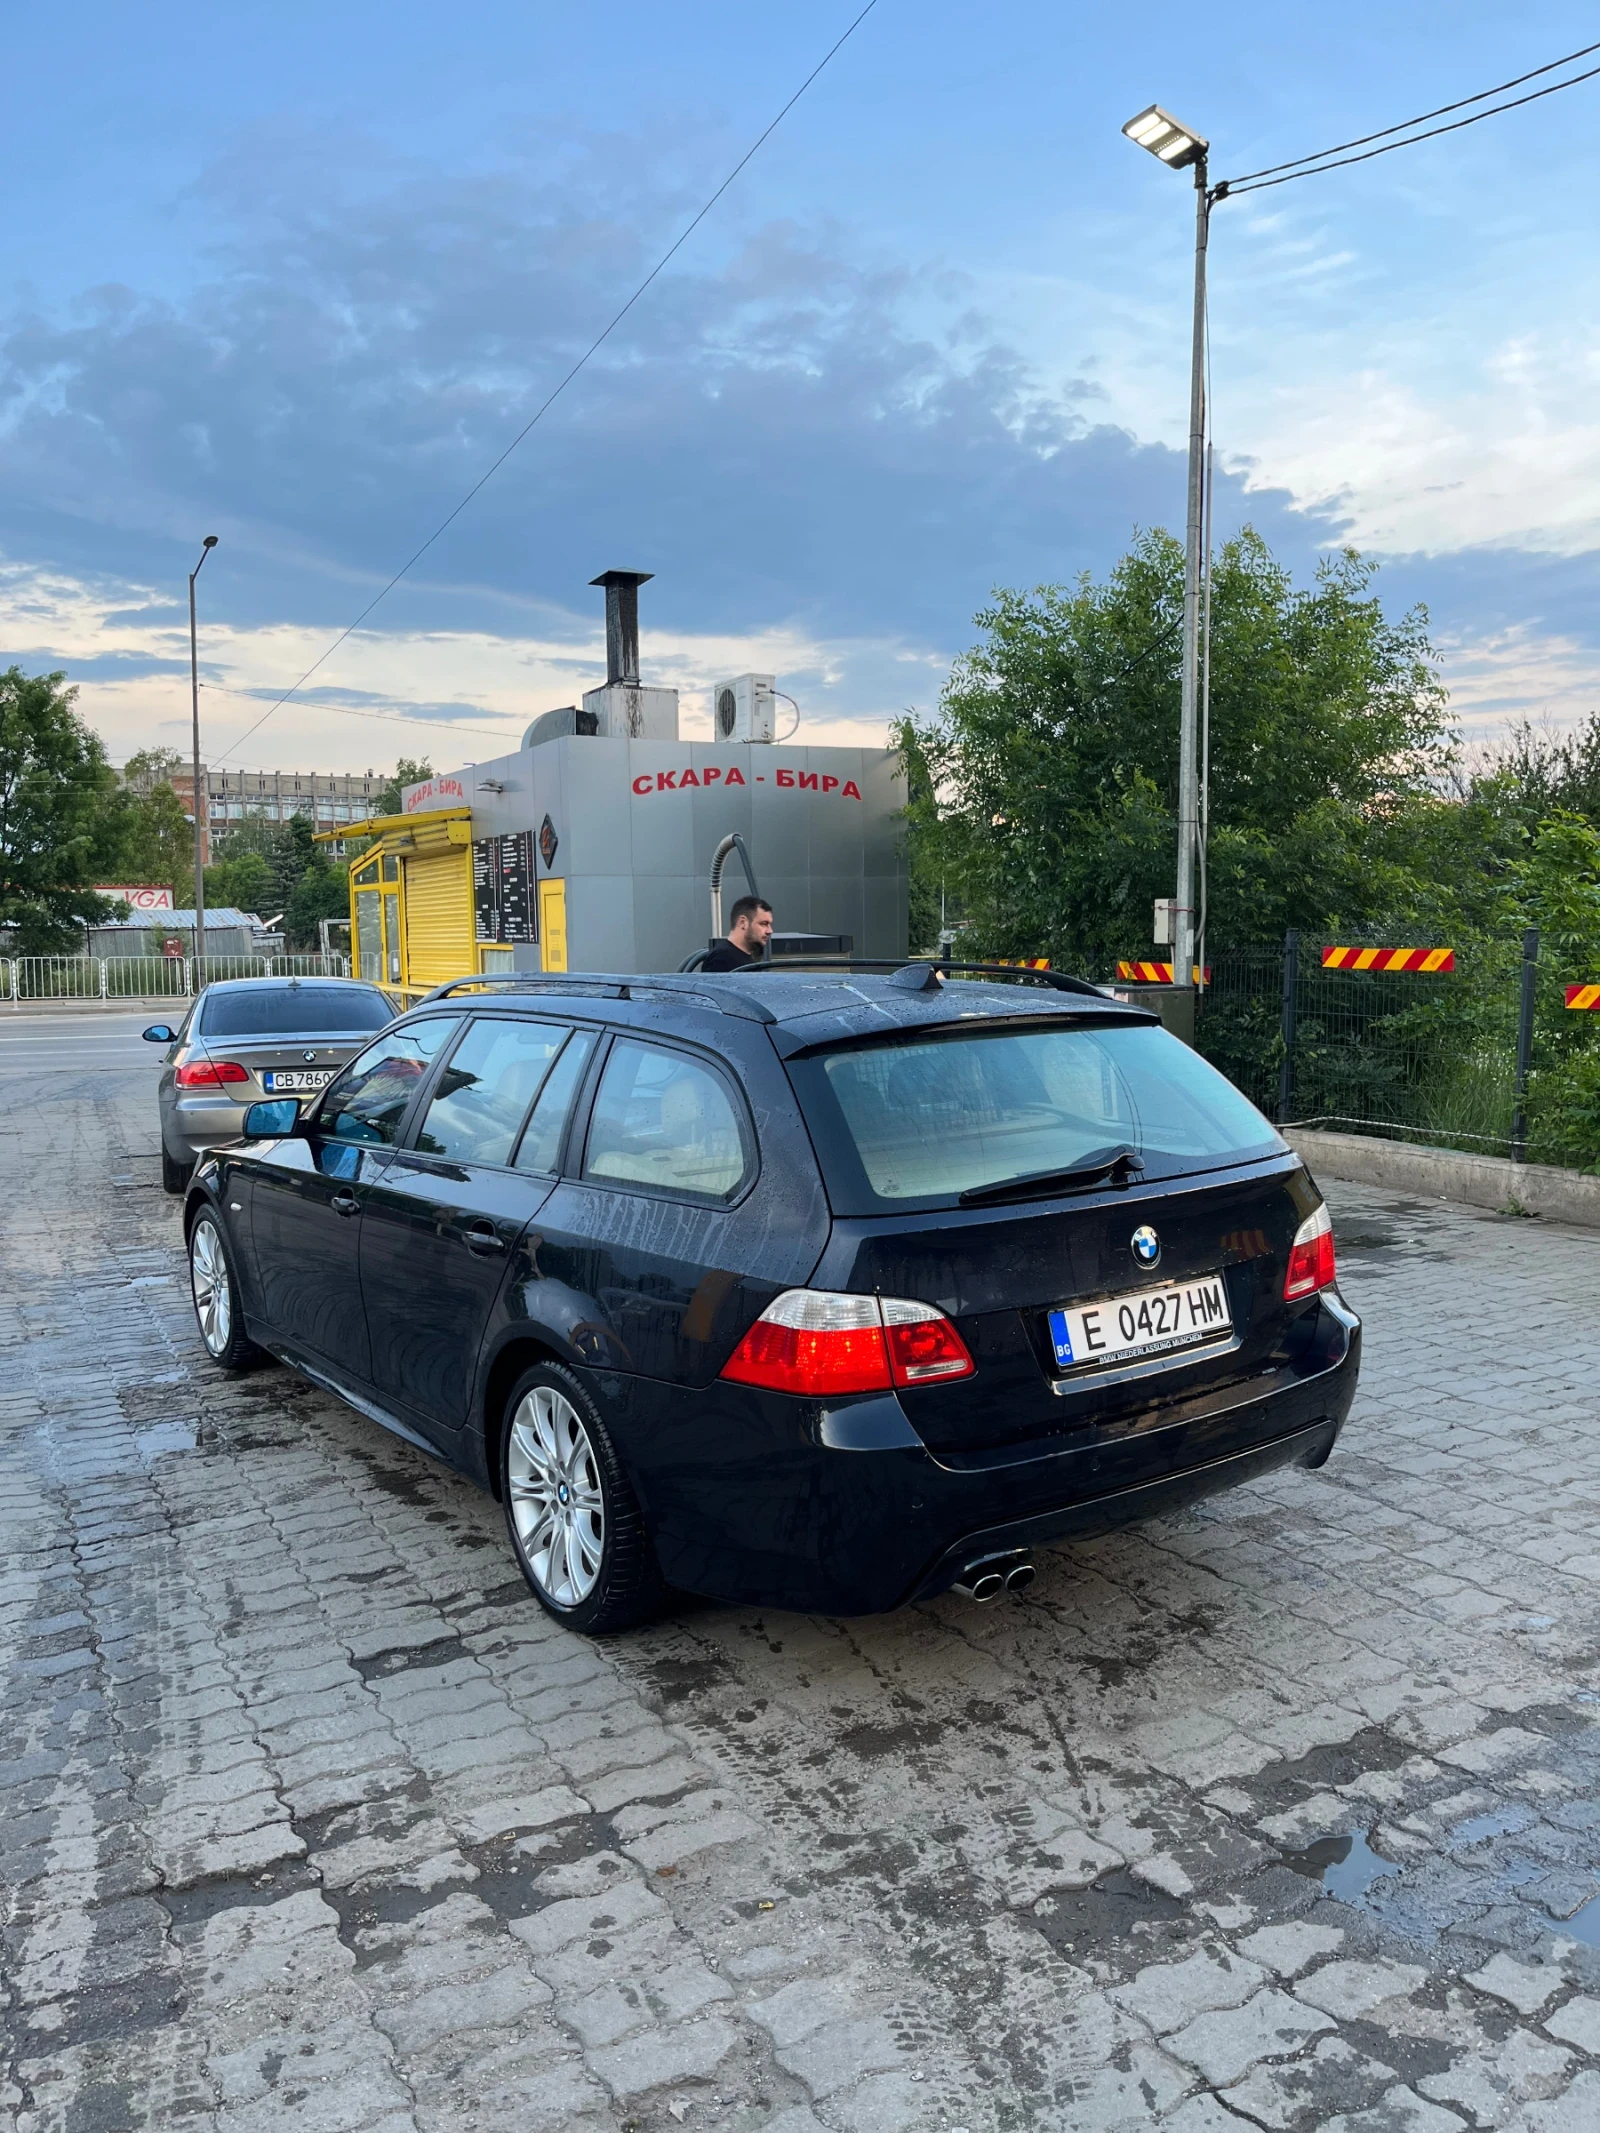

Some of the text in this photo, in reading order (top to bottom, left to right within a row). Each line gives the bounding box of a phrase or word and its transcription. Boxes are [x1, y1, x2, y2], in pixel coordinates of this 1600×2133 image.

[407, 783, 432, 812] СКАРА
[439, 779, 463, 799] БИРА
[632, 767, 746, 796] СКАРА
[776, 769, 861, 800] БИРА
[125, 890, 169, 908] VGA
[276, 1073, 294, 1087] CB
[1081, 1284, 1223, 1351] E 0427 HM
[1056, 1344, 1071, 1357] BG
[1099, 1352, 1117, 1364] BMW
[1117, 1340, 1171, 1360] NIEDERLASSUNG
